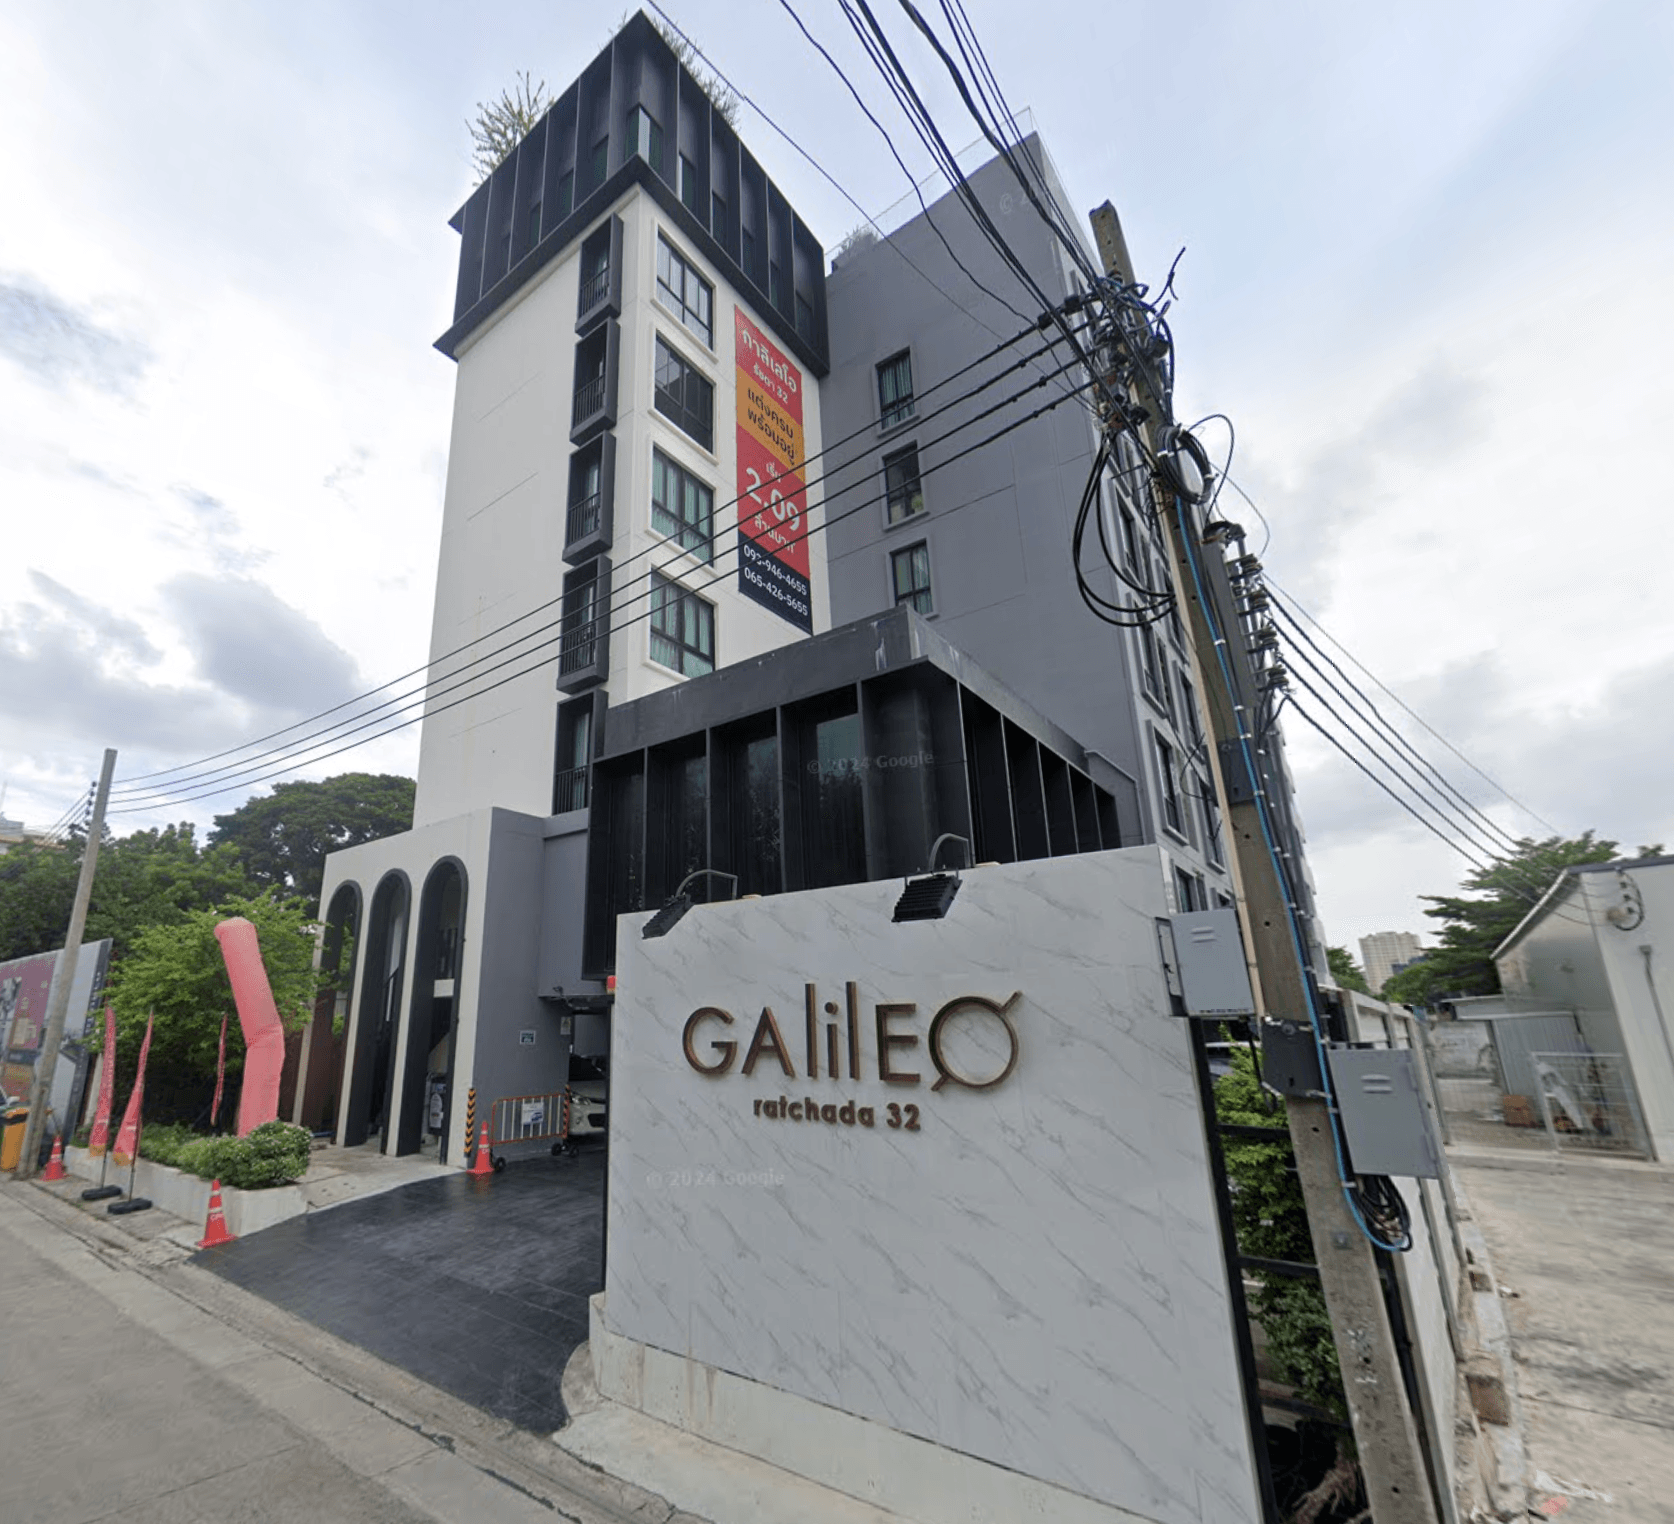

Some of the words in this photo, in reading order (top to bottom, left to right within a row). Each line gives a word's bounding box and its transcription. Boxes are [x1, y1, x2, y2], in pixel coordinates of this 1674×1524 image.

[742, 328, 797, 393] กาลิเลโอ
[747, 387, 794, 439] แต่งครบ
[776, 387, 789, 405] 32
[747, 408, 795, 466] พร้อมอยู่
[746, 467, 800, 531] 2.09
[744, 566, 809, 617] 065-426-5655
[753, 1095, 875, 1129] ratchada
[886, 1102, 921, 1132] 32
